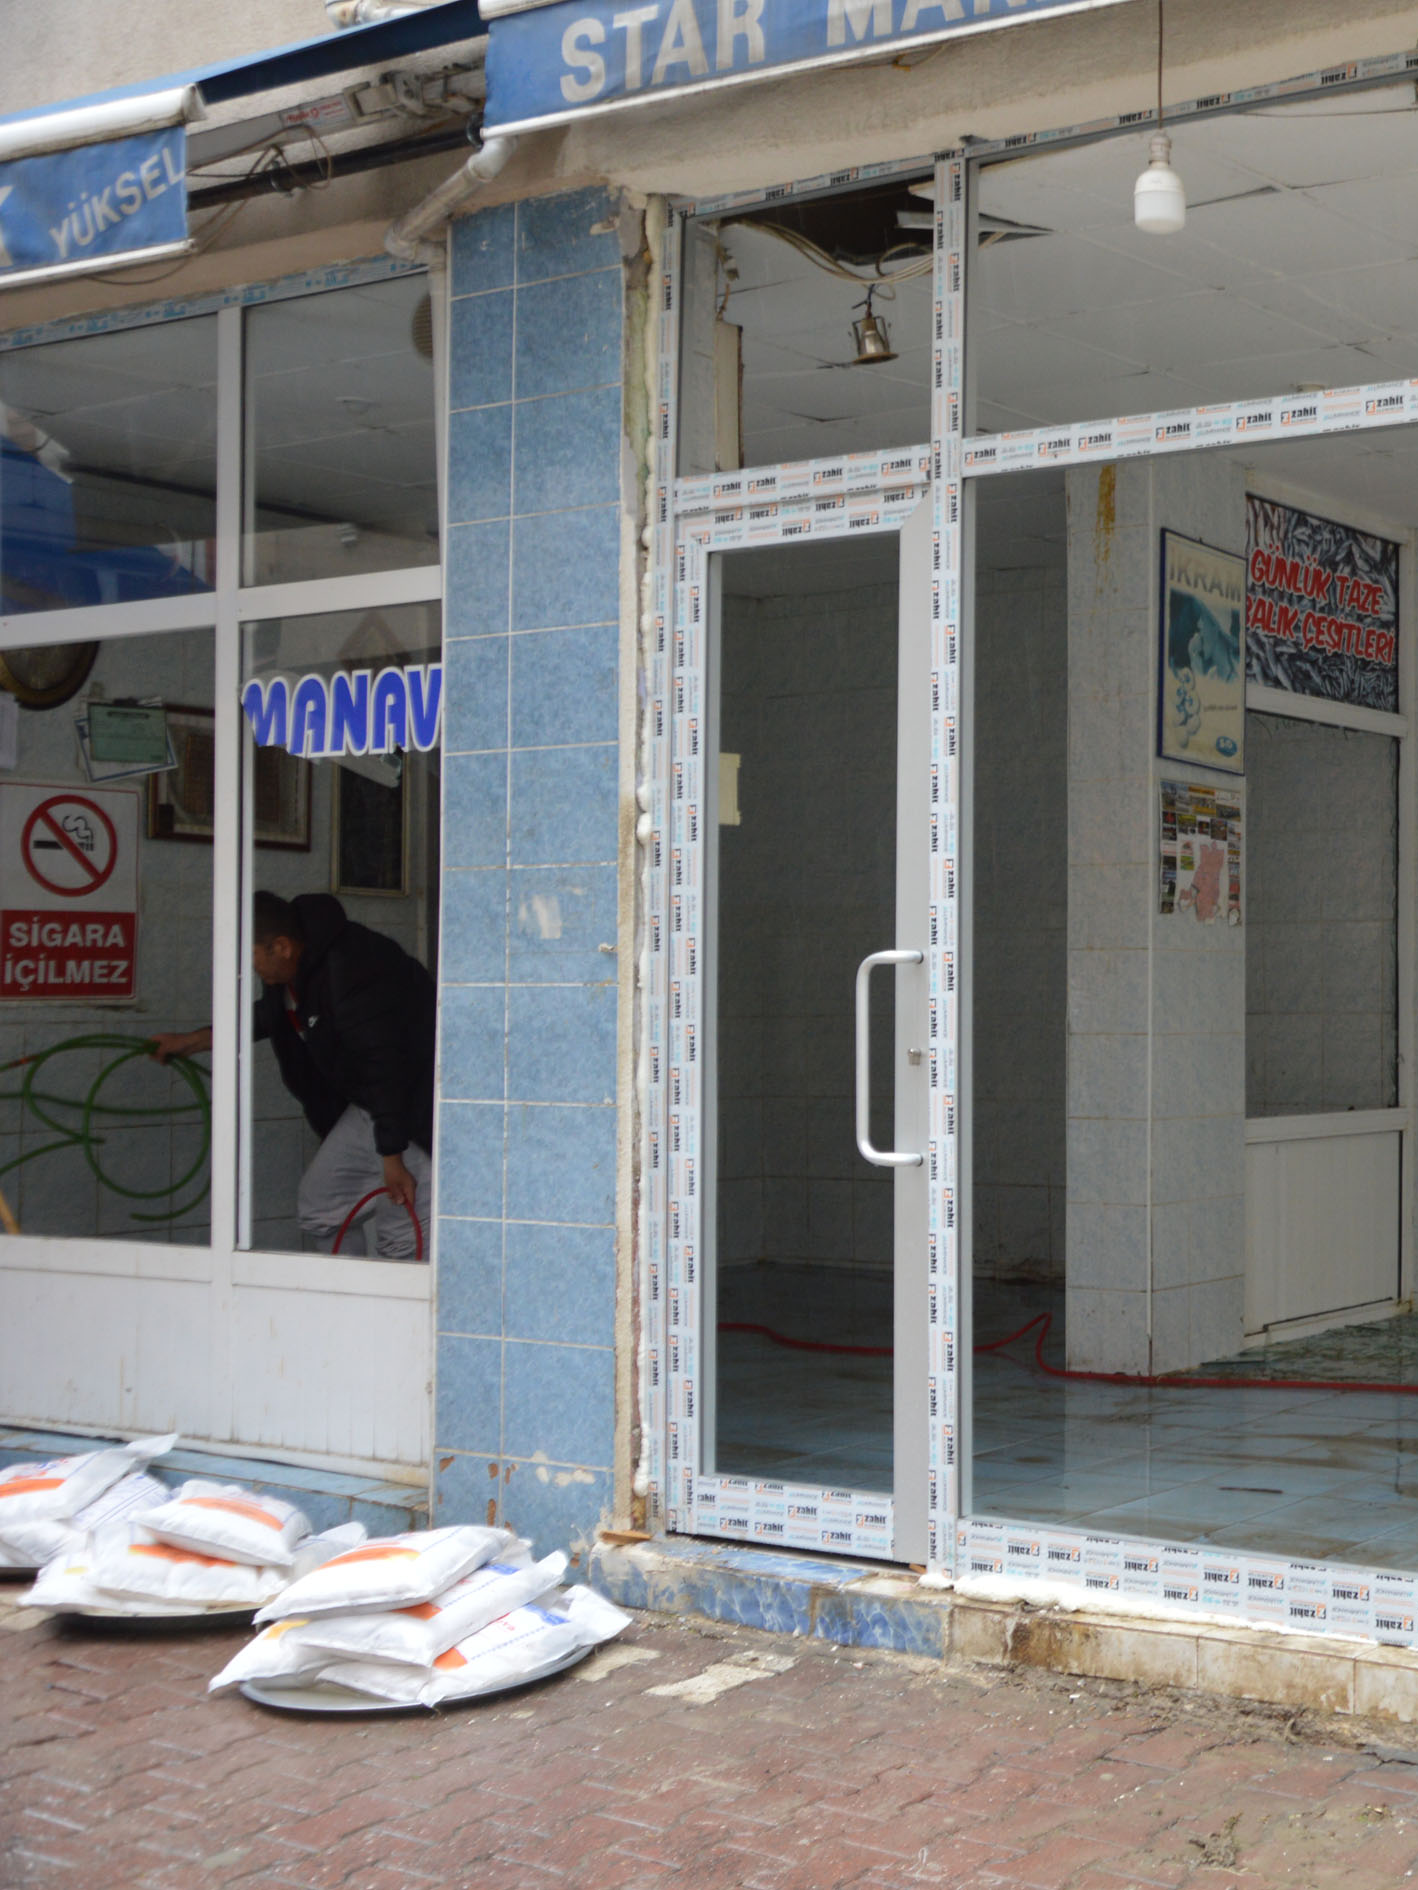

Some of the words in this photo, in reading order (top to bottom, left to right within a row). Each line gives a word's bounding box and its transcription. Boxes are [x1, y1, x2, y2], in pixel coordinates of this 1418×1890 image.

[559, 0, 766, 102] STAR
[49, 146, 186, 259] YÜKSEL
[1251, 543, 1331, 601] GÜNLÜK
[1335, 574, 1383, 615] TAZE
[1302, 610, 1394, 663] ÇEŞİTLERİ
[241, 664, 443, 759] MANAV
[8, 917, 126, 950] SİGARA
[3, 954, 129, 992] İÇİLMEZ
